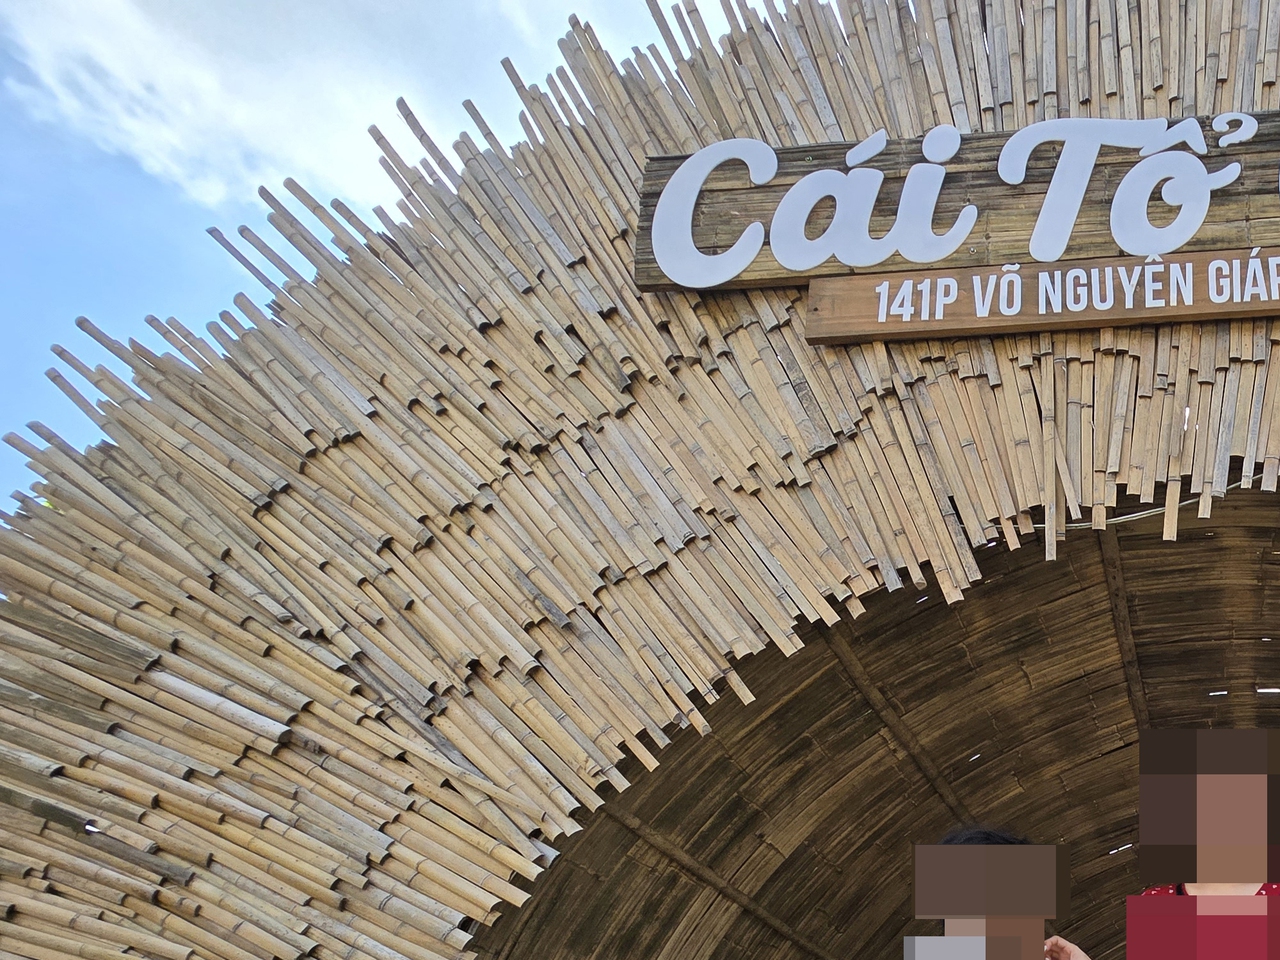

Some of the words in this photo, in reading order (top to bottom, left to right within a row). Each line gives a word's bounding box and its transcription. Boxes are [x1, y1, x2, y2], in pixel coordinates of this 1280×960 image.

[652, 125, 977, 288] Cái
[998, 113, 1258, 262] Tổ
[876, 279, 957, 323] 141P
[973, 264, 1022, 318] VÕ
[1038, 254, 1194, 315] NGUYÊN
